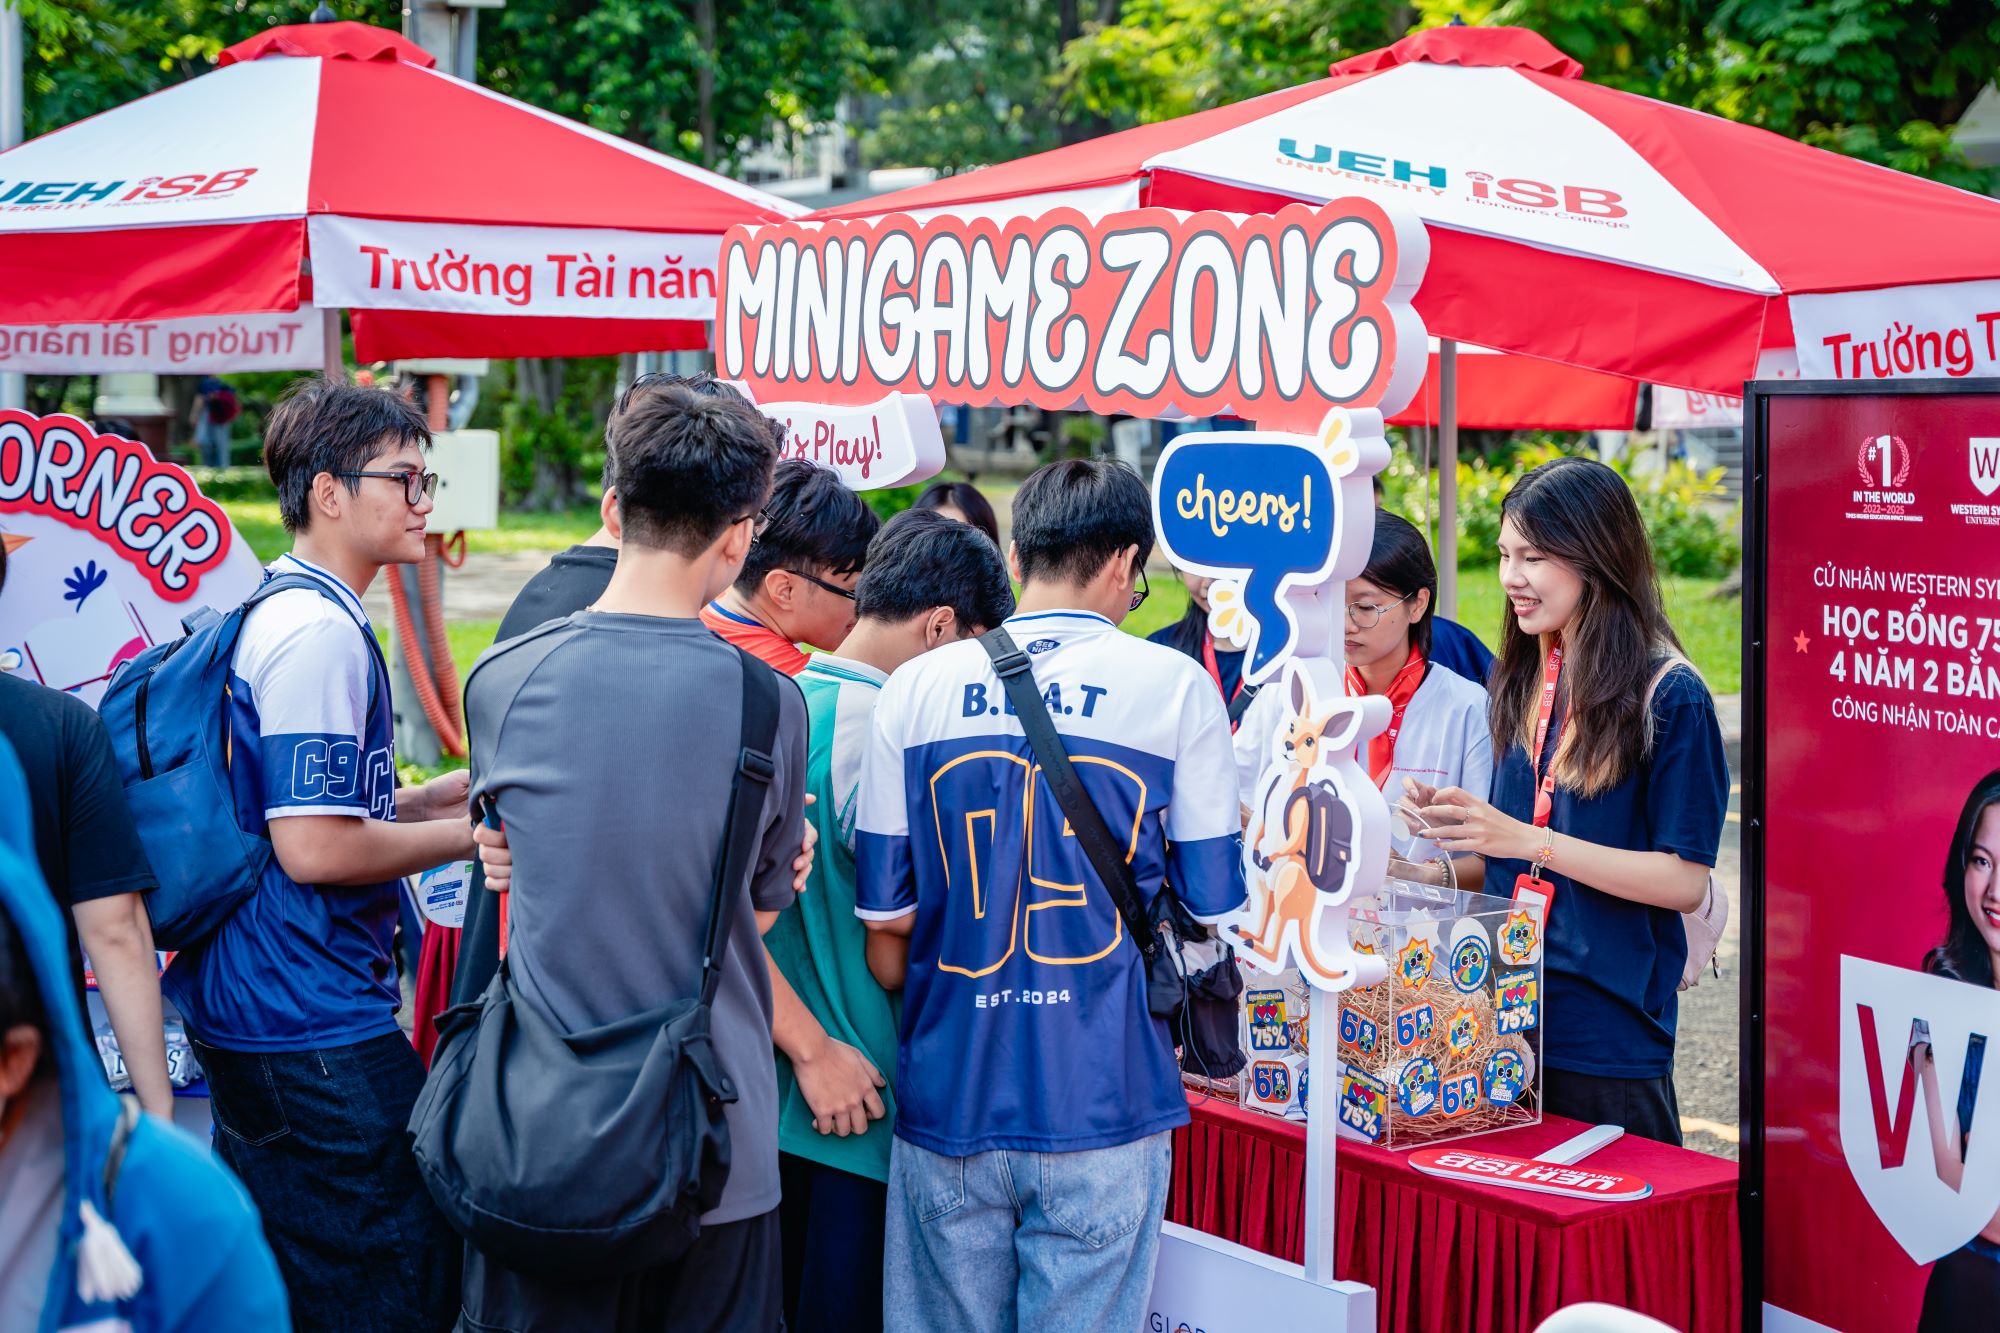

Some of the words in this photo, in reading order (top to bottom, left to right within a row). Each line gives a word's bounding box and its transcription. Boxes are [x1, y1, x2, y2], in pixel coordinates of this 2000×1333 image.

[1275, 157, 1446, 197] UNIVERSITY
[1278, 138, 1447, 188] UEH
[1465, 196, 1548, 216] Honours
[1554, 211, 1630, 229] College
[360, 245, 532, 305] Trường
[547, 253, 616, 299] Tài
[629, 255, 717, 299] năn
[724, 224, 1090, 390] MINIGAME
[1094, 216, 1385, 400] ZONE
[1823, 321, 1974, 379] Trường
[813, 415, 883, 480] Play!
[1868, 434, 1892, 488] #1
[0, 420, 221, 590] ORNER
[1176, 472, 1313, 538] cheers!
[1853, 490, 1863, 502] IN
[1864, 491, 1881, 503] THE
[1882, 492, 1915, 505] WORLD
[1951, 504, 1990, 516] WESTERN
[1813, 561, 1836, 587] CỬ
[1839, 566, 1885, 591] NHÂN
[1890, 573, 1971, 598] WESTERN
[1823, 604, 1880, 646] HỌC
[1888, 597, 1968, 649] BỔNG
[1829, 650, 1847, 682] 4
[1854, 647, 1915, 691] NĂM
[1922, 660, 1939, 693] 2
[1832, 695, 1878, 722] CÔNG
[1882, 702, 1930, 732] NHẬN
[1934, 708, 1982, 736] TOÀN
[1986, 717, 2000, 738] C
[292, 739, 359, 800] C9
[1251, 1025, 1288, 1048] 75%
[1499, 1004, 1535, 1032] 75%
[1342, 1098, 1378, 1137] 75%
[1856, 1002, 1988, 1195] W
[1518, 1168, 1616, 1191] UEH
[1534, 1165, 1624, 1182] UNIVERSITY
